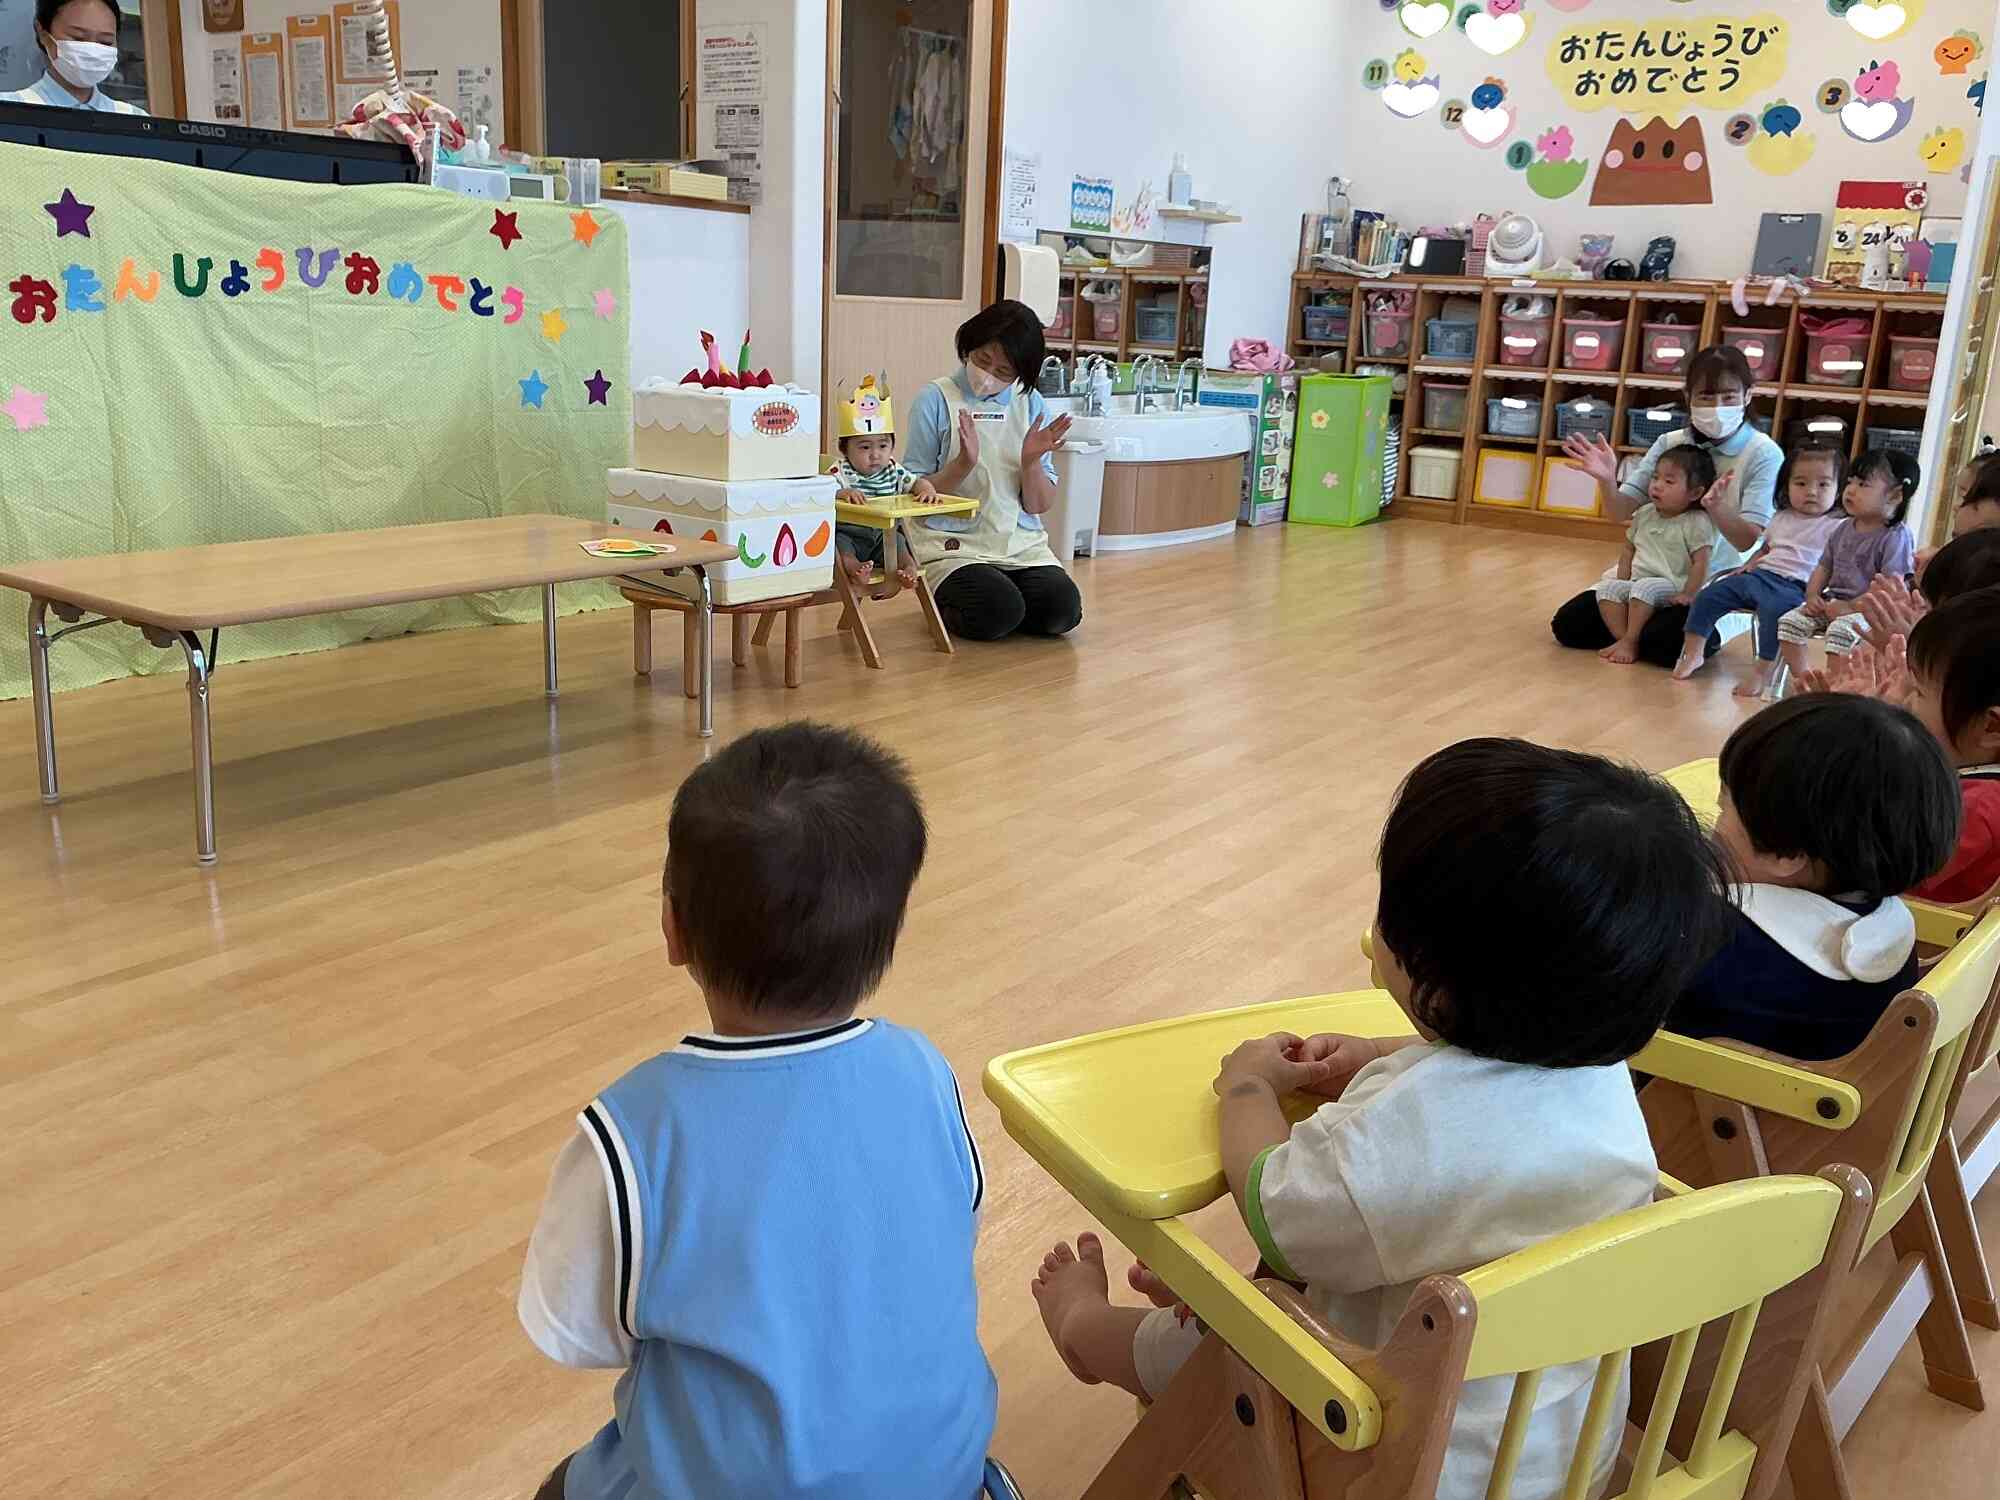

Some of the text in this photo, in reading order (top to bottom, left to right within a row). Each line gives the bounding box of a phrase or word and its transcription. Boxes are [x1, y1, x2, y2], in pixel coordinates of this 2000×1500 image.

[1560, 24, 1779, 63] おたんじょうび
[1369, 66, 1383, 81] 11
[1575, 59, 1740, 96] おめでとう
[1825, 87, 1842, 105] 3
[1446, 107, 1463, 122] 12
[178, 123, 227, 138] CASIO
[1731, 120, 1750, 139] 2
[1514, 146, 1524, 164] 1
[1862, 232, 1881, 245] 24
[864, 419, 872, 432] 1
